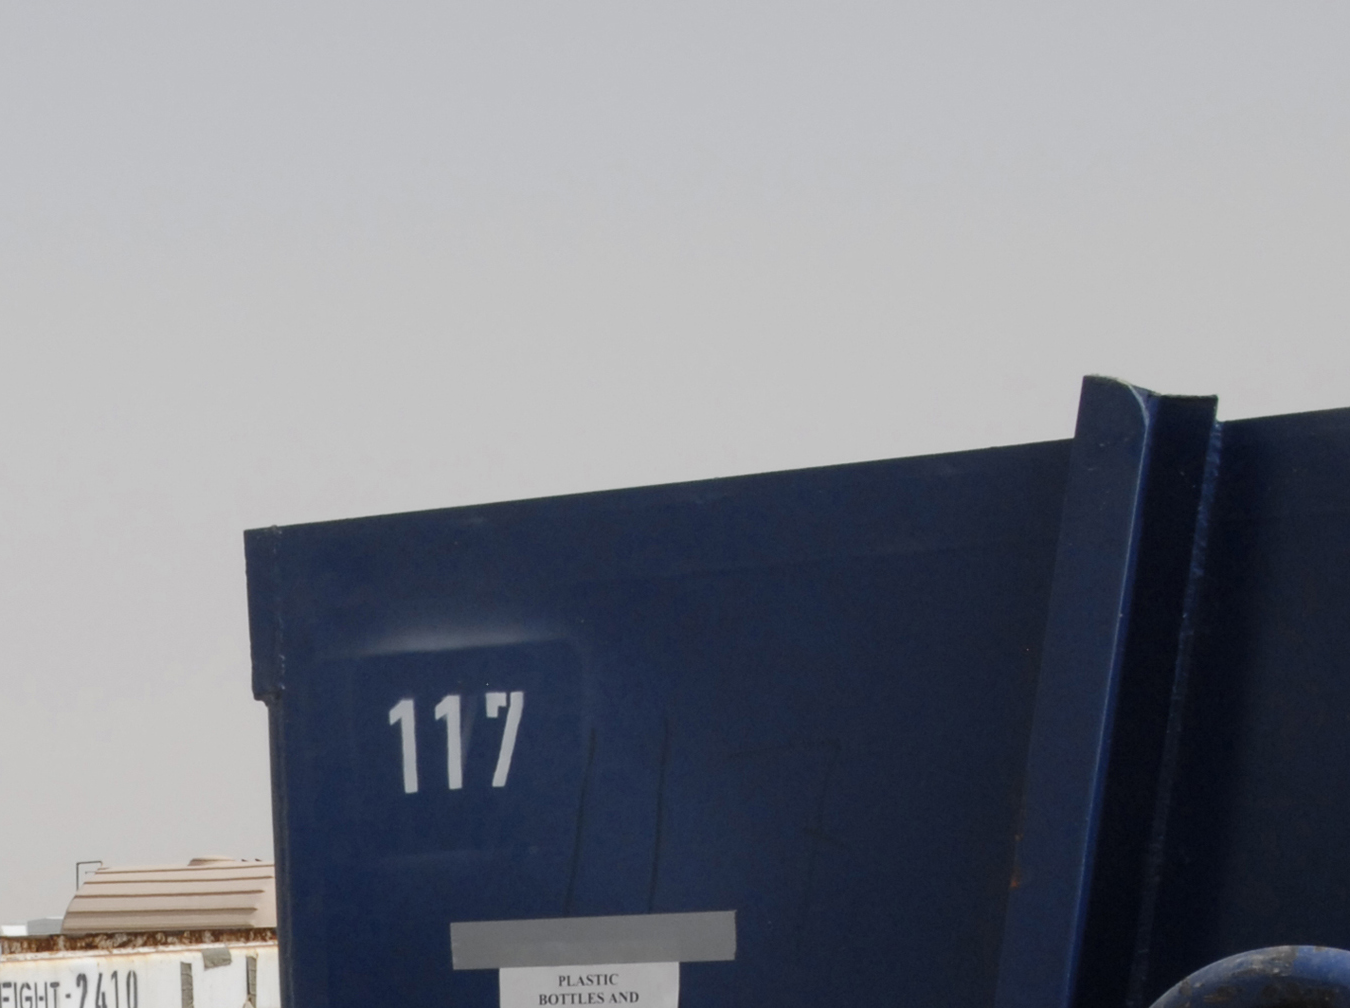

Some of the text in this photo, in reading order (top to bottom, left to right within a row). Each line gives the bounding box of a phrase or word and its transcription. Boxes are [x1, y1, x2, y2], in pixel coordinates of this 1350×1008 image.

[389, 691, 524, 793] 117
[558, 973, 619, 987] PLASTIC
[538, 991, 640, 1006] BOTTLES AND
